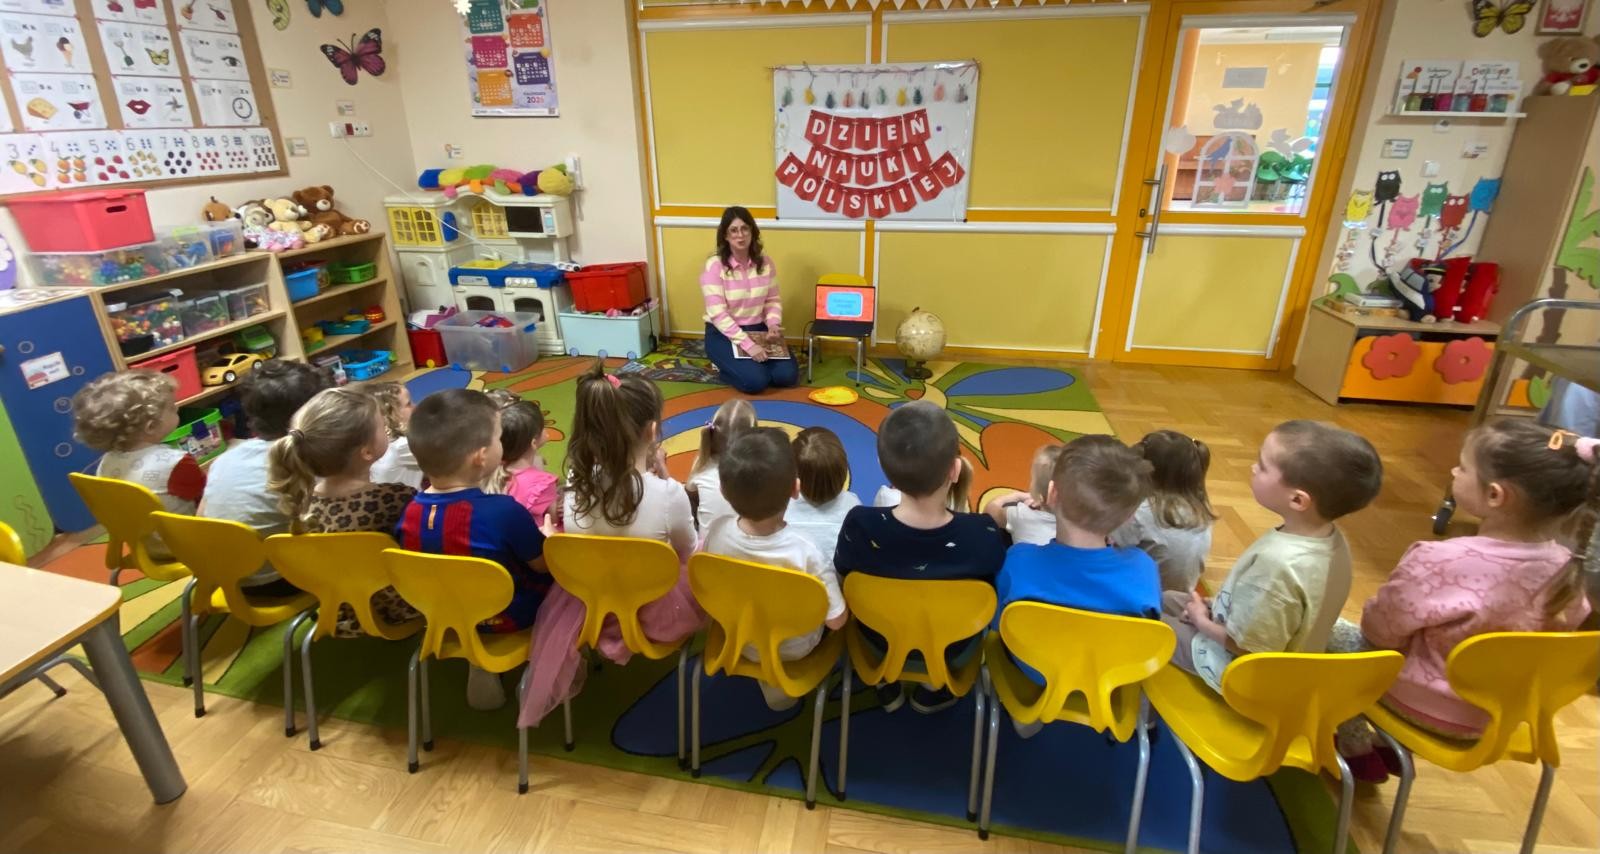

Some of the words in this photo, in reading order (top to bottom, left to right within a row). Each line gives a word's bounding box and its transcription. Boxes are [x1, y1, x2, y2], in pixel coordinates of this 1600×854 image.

[811, 113, 925, 141] DZIEŃ
[7, 144, 20, 159] 3
[50, 140, 61, 158] 4
[88, 139, 100, 153] 5
[126, 137, 136, 151] 6
[160, 136, 167, 149] 7
[191, 136, 200, 148] 8
[221, 135, 230, 148] 9
[811, 147, 923, 178] NAUKI
[783, 161, 956, 208] POLSKIEJ
